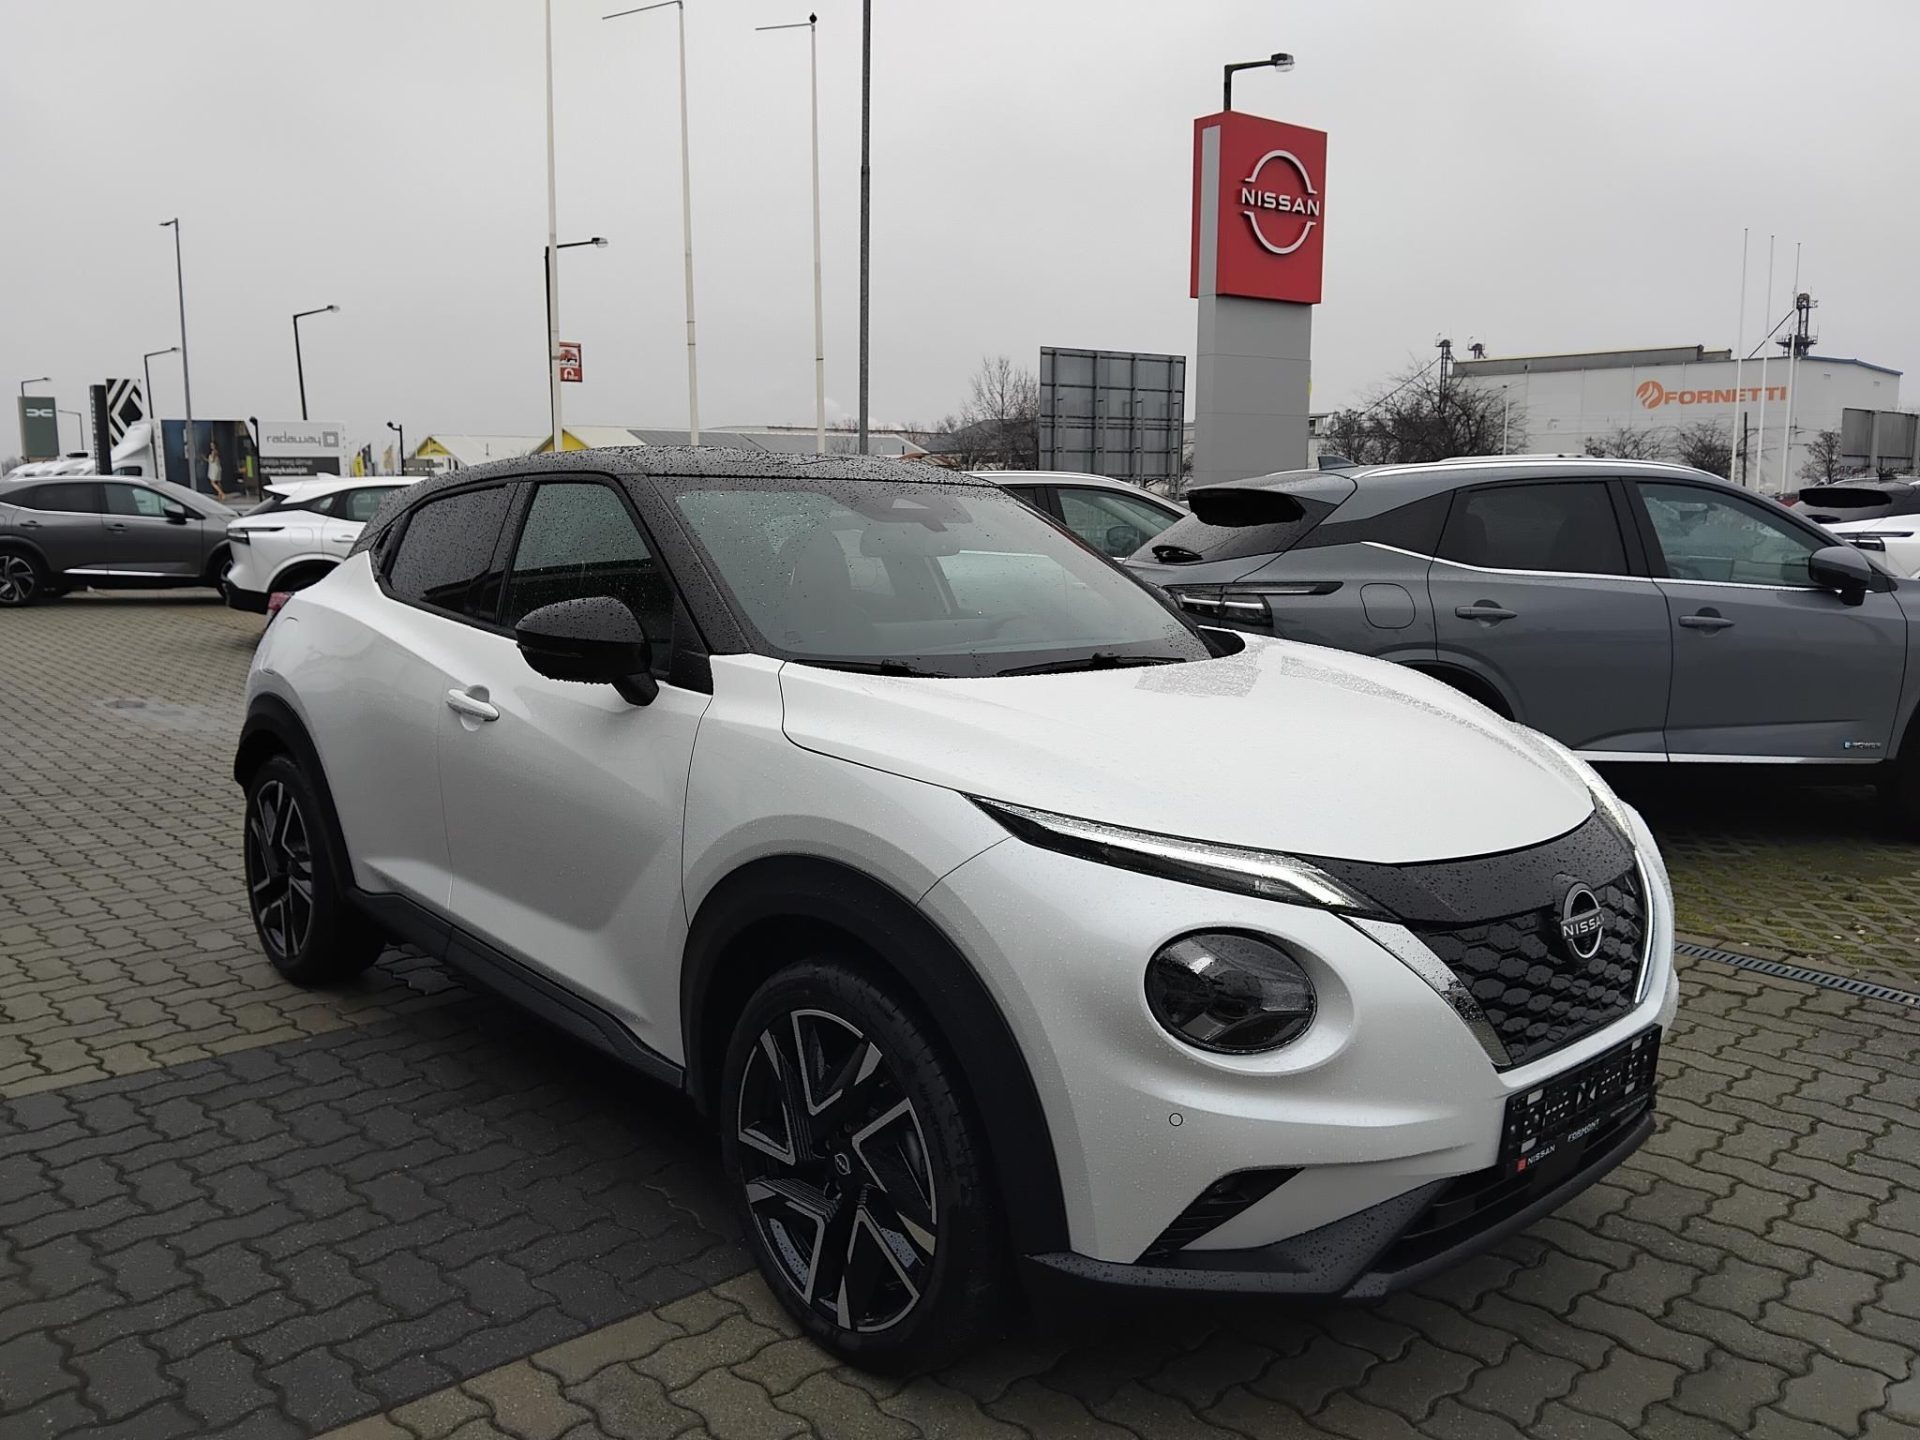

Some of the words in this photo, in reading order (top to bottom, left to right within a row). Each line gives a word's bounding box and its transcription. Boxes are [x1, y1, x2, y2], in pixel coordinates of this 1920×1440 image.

[1241, 186, 1320, 217] NISSAN
[1664, 386, 1787, 405] FORNETTI
[266, 431, 322, 448] radaway
[1563, 914, 1603, 937] NISSA
[1527, 1144, 1556, 1166] NISSAN
